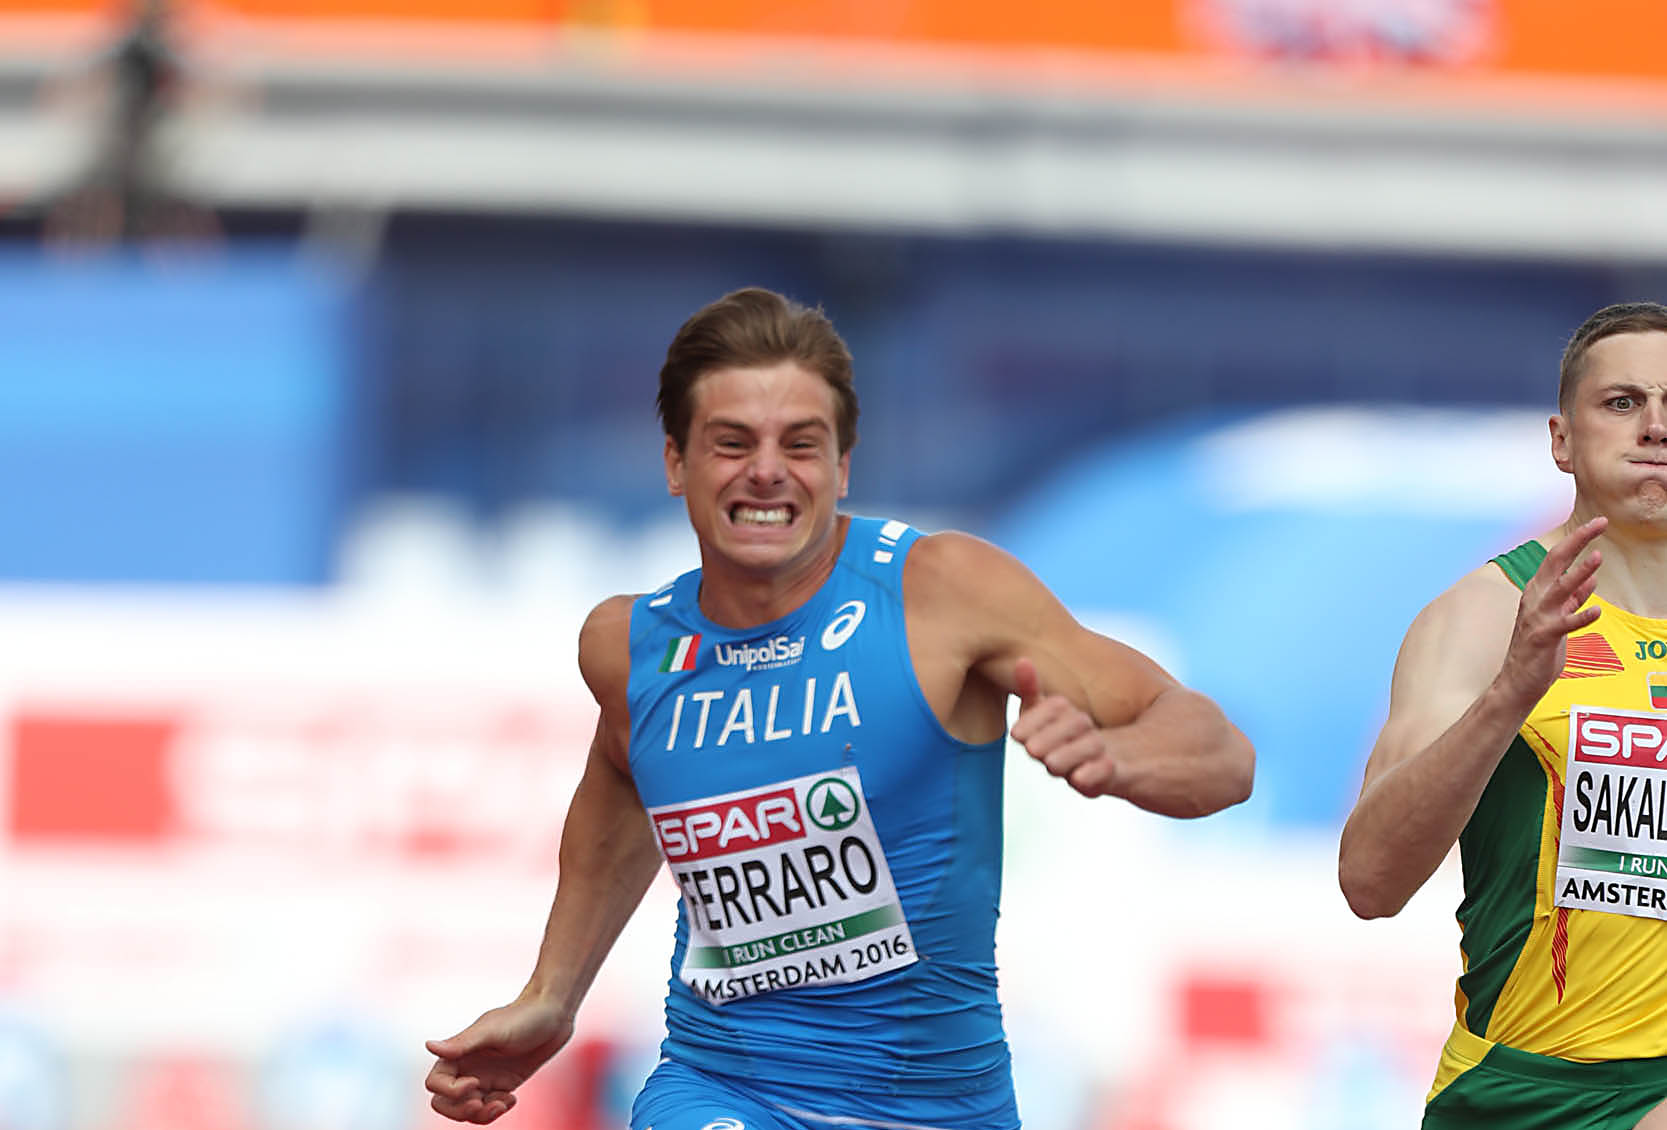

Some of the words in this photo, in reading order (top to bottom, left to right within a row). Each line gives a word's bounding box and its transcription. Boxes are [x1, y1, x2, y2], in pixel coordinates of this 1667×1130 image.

[1635, 640, 1667, 660] JO
[666, 671, 862, 752] ITALIA
[660, 796, 800, 858] SPAR
[1619, 855, 1625, 872] I
[1562, 877, 1667, 911] AMSTER
[732, 940, 777, 963] RUN
[780, 922, 846, 953] CLEAN
[851, 934, 908, 971] 2016
